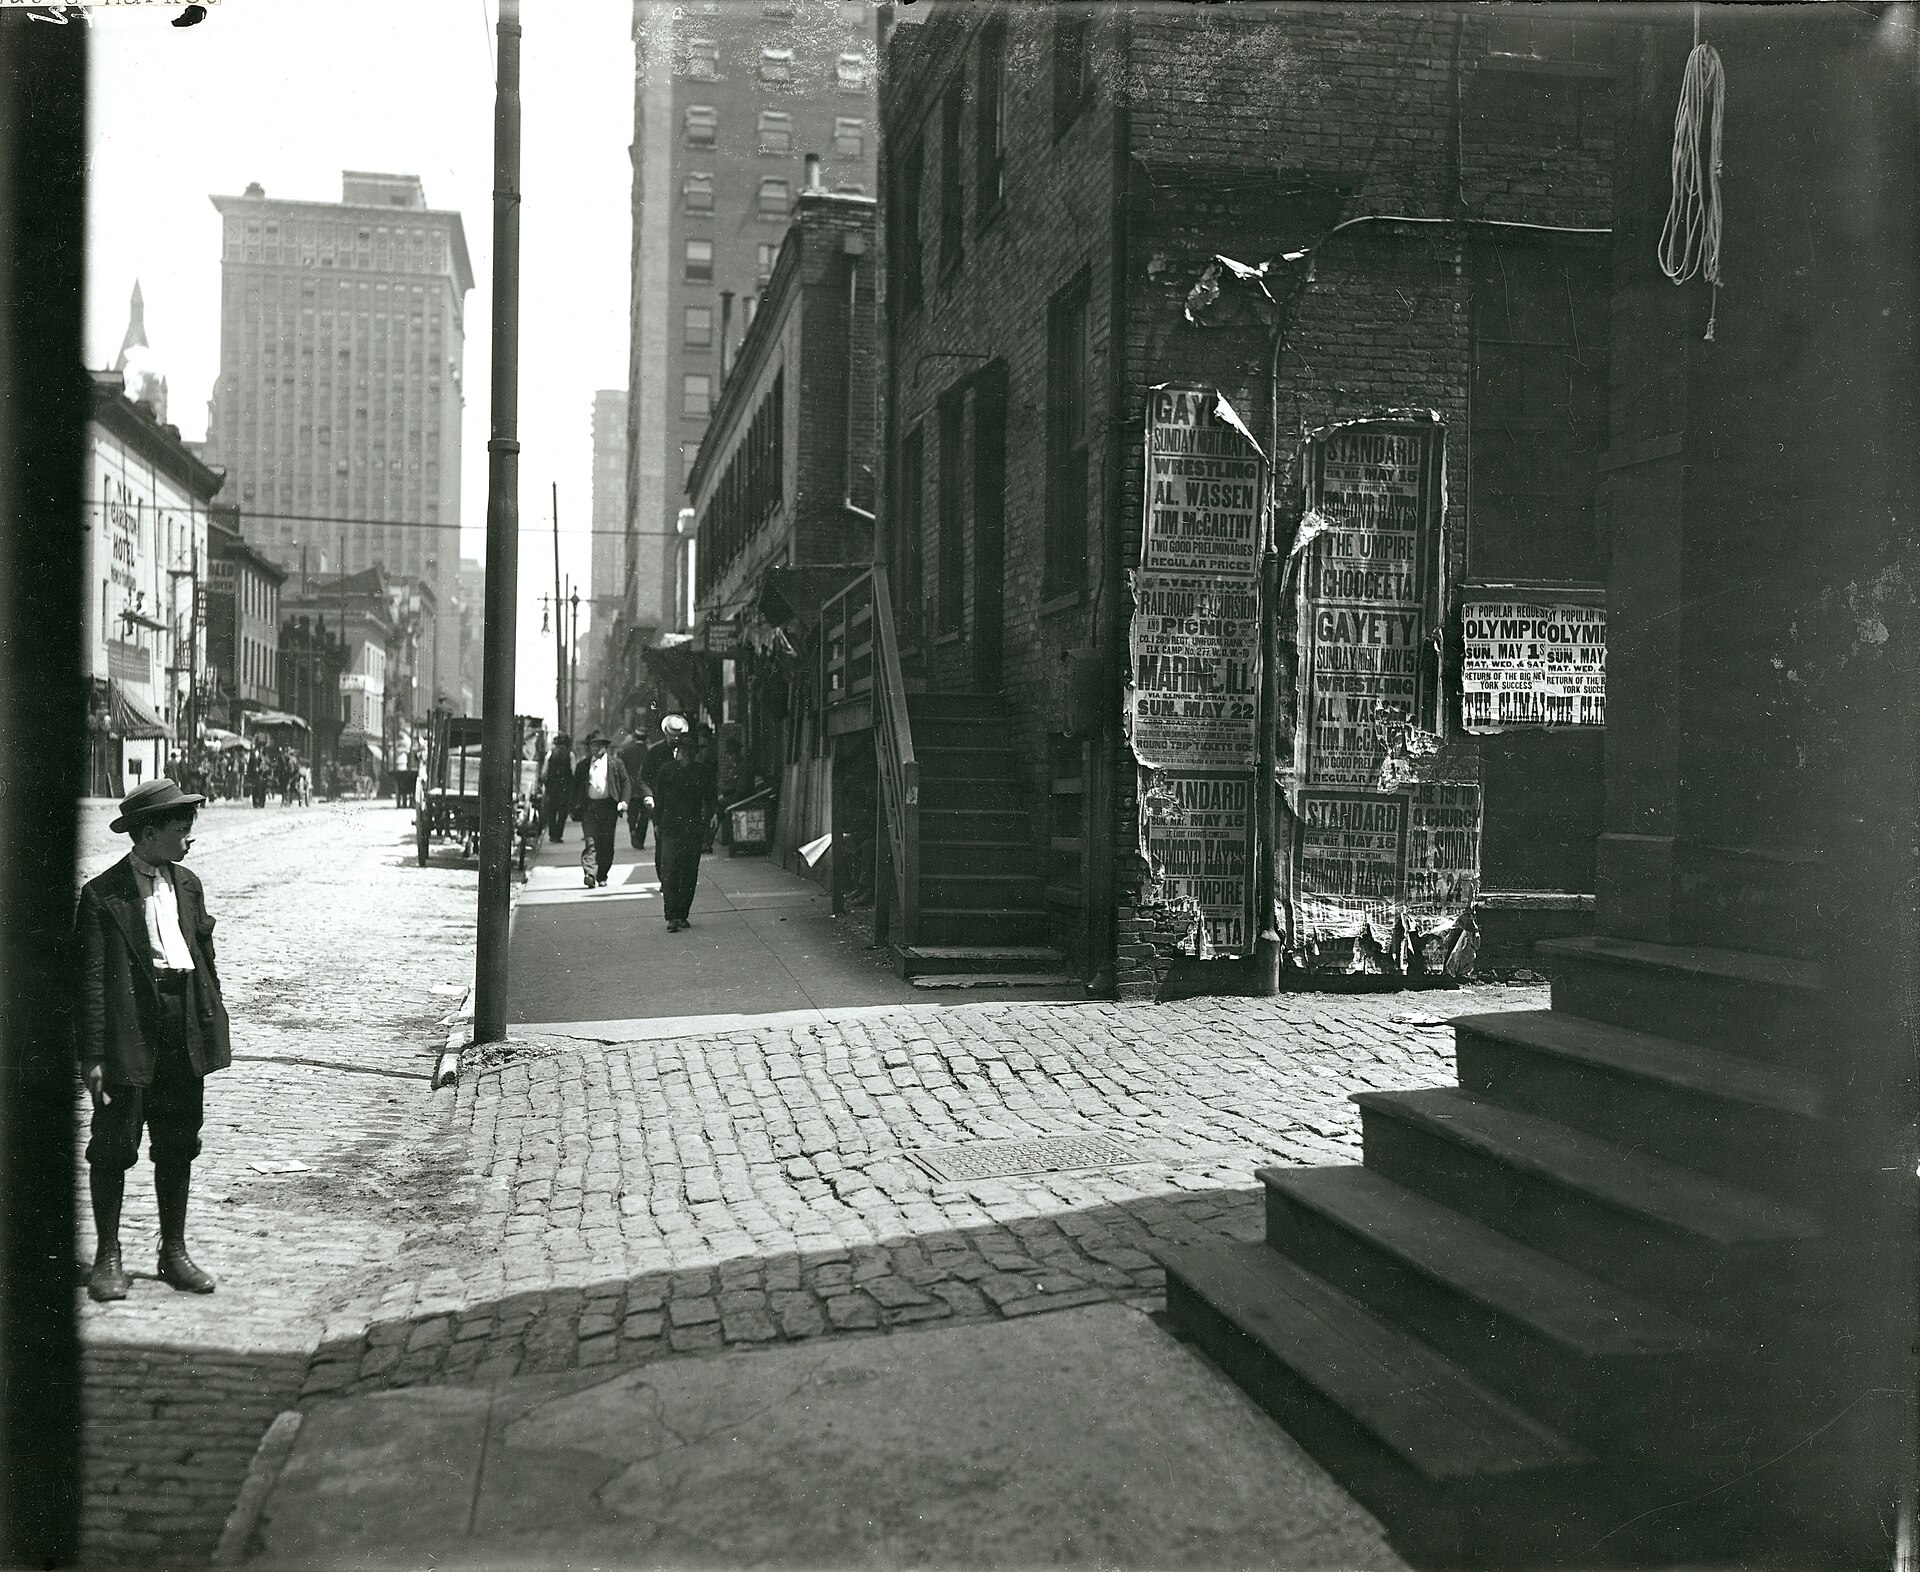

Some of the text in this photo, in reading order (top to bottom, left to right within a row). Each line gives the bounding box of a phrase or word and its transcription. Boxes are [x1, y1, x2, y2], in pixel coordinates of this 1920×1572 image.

[1154, 427, 1196, 454] SUNDAY
[1326, 434, 1420, 468] STANDARD
[1154, 458, 1257, 480] WRESTLING
[1154, 481, 1254, 509] AL. WASSEN
[1153, 510, 1253, 539] TIM McCARTHY
[1151, 540, 1168, 553] TWO
[1169, 541, 1191, 553] GOOD
[1193, 542, 1253, 557] PRELIMINARIES
[1325, 532, 1415, 560] THE UMPIRE
[1151, 557, 1251, 571] REGULAR PRICES
[1323, 569, 1413, 601] CHOOCEETA
[1140, 590, 1256, 619] RAILROAD EXCURSION
[1466, 606, 1475, 618] BY
[1479, 606, 1513, 618] POPULAR
[1561, 610, 1595, 623] POPULAR
[1161, 617, 1237, 637] PICNIC
[1318, 611, 1416, 646] GAYETY
[1466, 620, 1548, 639] OLYMPIC
[1147, 645, 1160, 654] ELK
[1162, 646, 1182, 654] CAMP
[1316, 645, 1357, 671] SUNDAY
[1357, 647, 1379, 672] NIGHT
[1381, 648, 1402, 673] MAY
[1466, 647, 1494, 659] SUN.
[1498, 643, 1522, 660] MAY
[1547, 647, 1604, 664] SUN. MAY
[1225, 658, 1255, 695] ILL.
[1316, 675, 1414, 695] WRESTLING
[1465, 672, 1491, 681] RETURN
[1493, 672, 1502, 680] OF
[1505, 672, 1517, 680] THE
[1519, 672, 1531, 681] BIG
[1480, 681, 1533, 690] YORK SUCCESS
[1546, 676, 1606, 685] RETURN OF THE B
[1562, 685, 1605, 694] YORK SUCCE
[1138, 699, 1254, 719] SUN. MAY 22
[1316, 698, 1340, 722] AL.
[1465, 691, 1491, 727] THE
[1546, 695, 1573, 727] THE
[1137, 739, 1168, 749] ROUND
[1194, 742, 1233, 752] TICKETS
[1315, 727, 1339, 751] TIM
[1313, 755, 1330, 768] TWO
[1331, 756, 1352, 769] GOOD
[1313, 773, 1366, 783] REGULAR
[1164, 781, 1245, 810] TANDARD
[1190, 814, 1220, 827] MAY
[1308, 801, 1398, 833] STANDARD
[1305, 836, 1322, 846] SUN.
[1323, 837, 1340, 847] MAT.
[1343, 834, 1373, 849] MAY
[1408, 872, 1441, 902] PRIL
